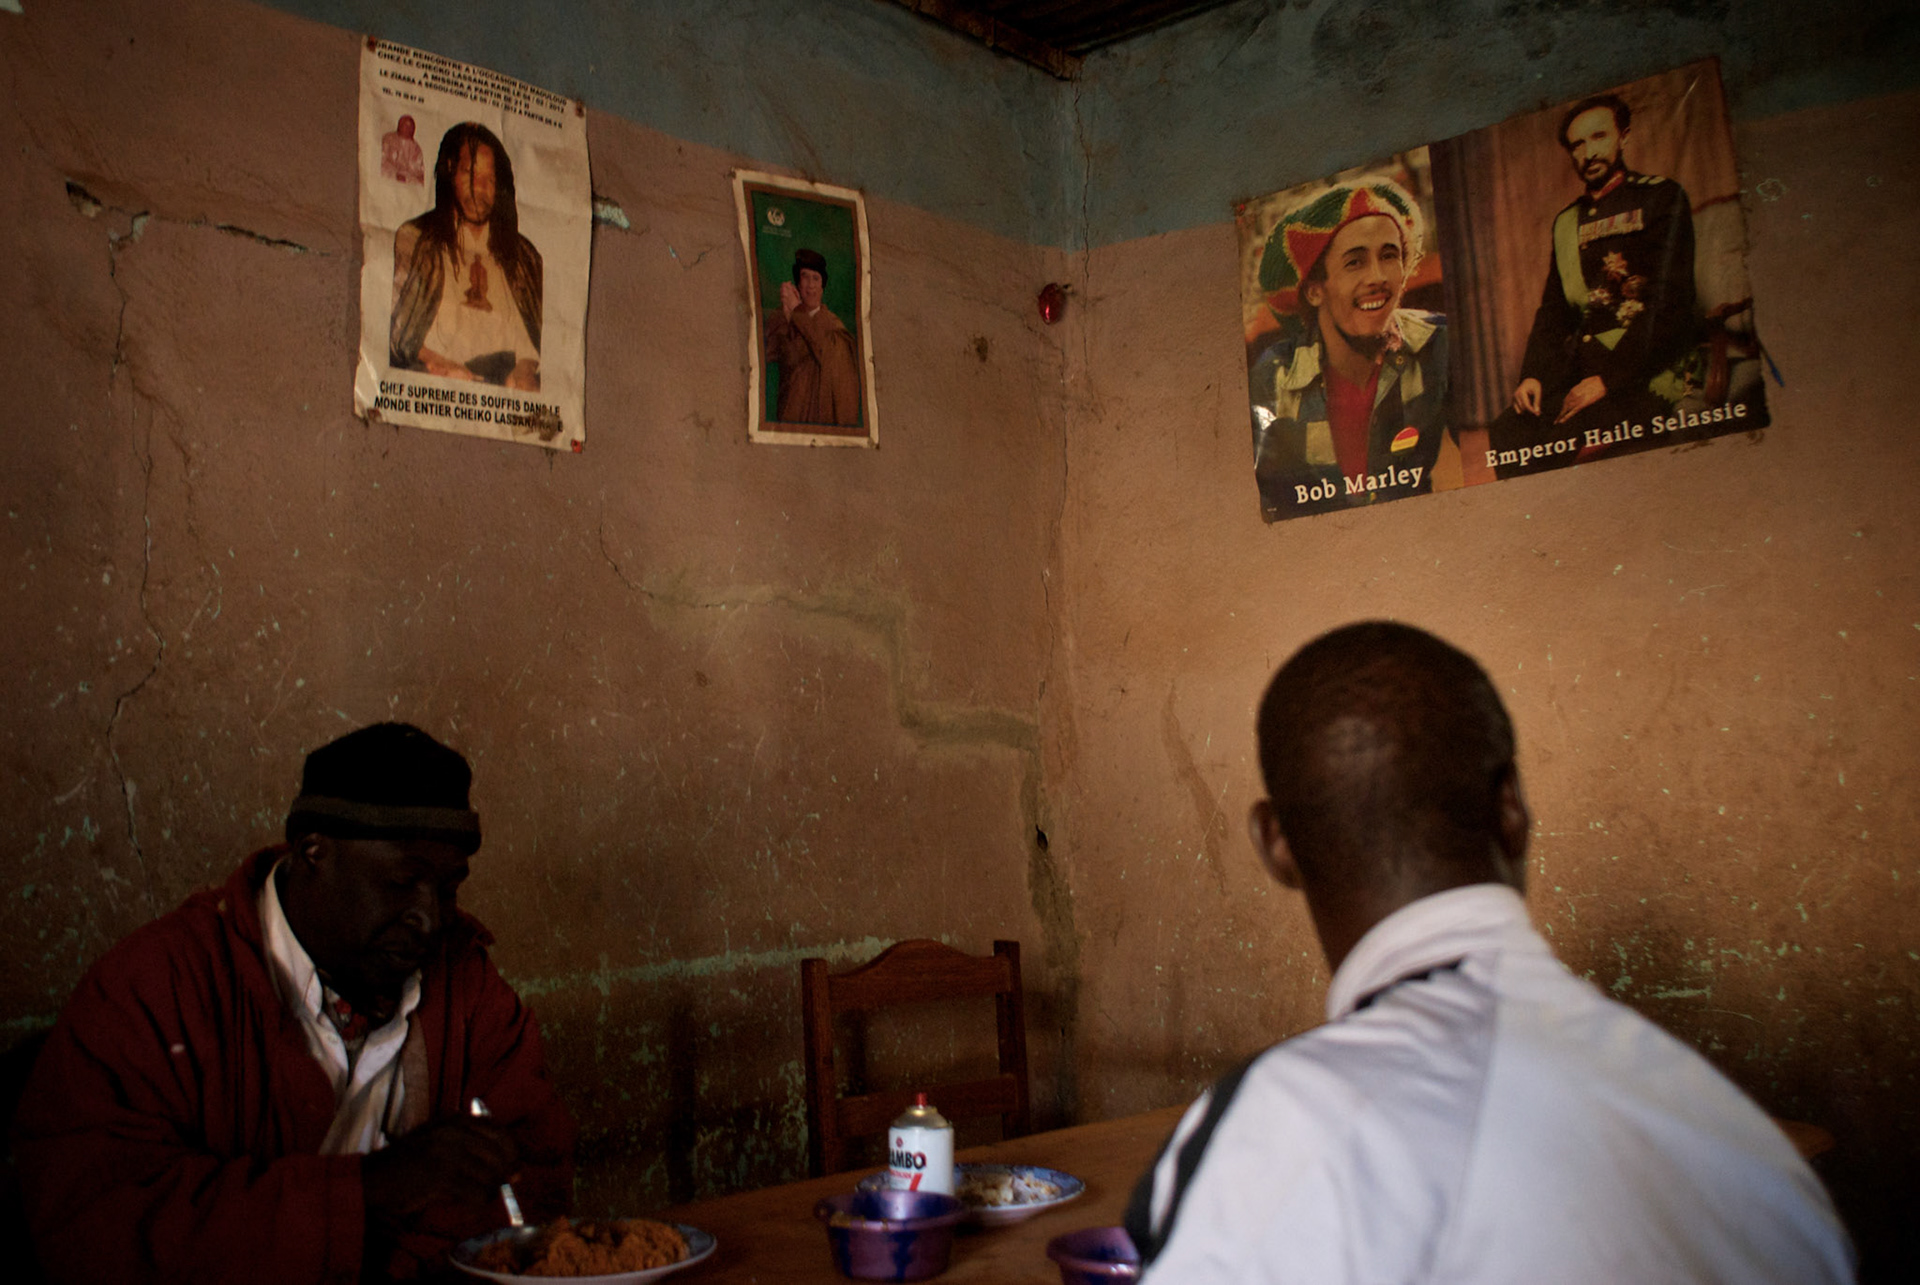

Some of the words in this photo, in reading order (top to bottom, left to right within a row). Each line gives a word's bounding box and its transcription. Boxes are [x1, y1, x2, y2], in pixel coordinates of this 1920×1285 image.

[377, 51, 401, 62] CHEZ
[403, 57, 412, 65] LE
[452, 72, 488, 87] LASSANA
[491, 81, 510, 93] KANE
[512, 88, 520, 97] LE
[379, 68, 388, 77] LE
[413, 51, 462, 70] RENCONTRE
[519, 81, 528, 90] DU
[431, 74, 464, 88] MISSIRA
[474, 85, 502, 99] PARTIR
[503, 94, 512, 103] DE
[374, 396, 411, 412] MONDE
[414, 401, 451, 418] ENTIER
[454, 406, 491, 422] CHEIKO
[380, 380, 404, 396] CHEF
[407, 385, 456, 403] SUPREME
[459, 392, 477, 406] DES
[481, 395, 520, 412] SOUFFIS
[1485, 436, 1577, 467] Emperor
[1584, 420, 1643, 448] Haile
[1651, 402, 1747, 435] Selassie
[1294, 477, 1336, 504] Bob
[1343, 464, 1423, 495] Marley
[889, 1148, 927, 1170] AMBO
